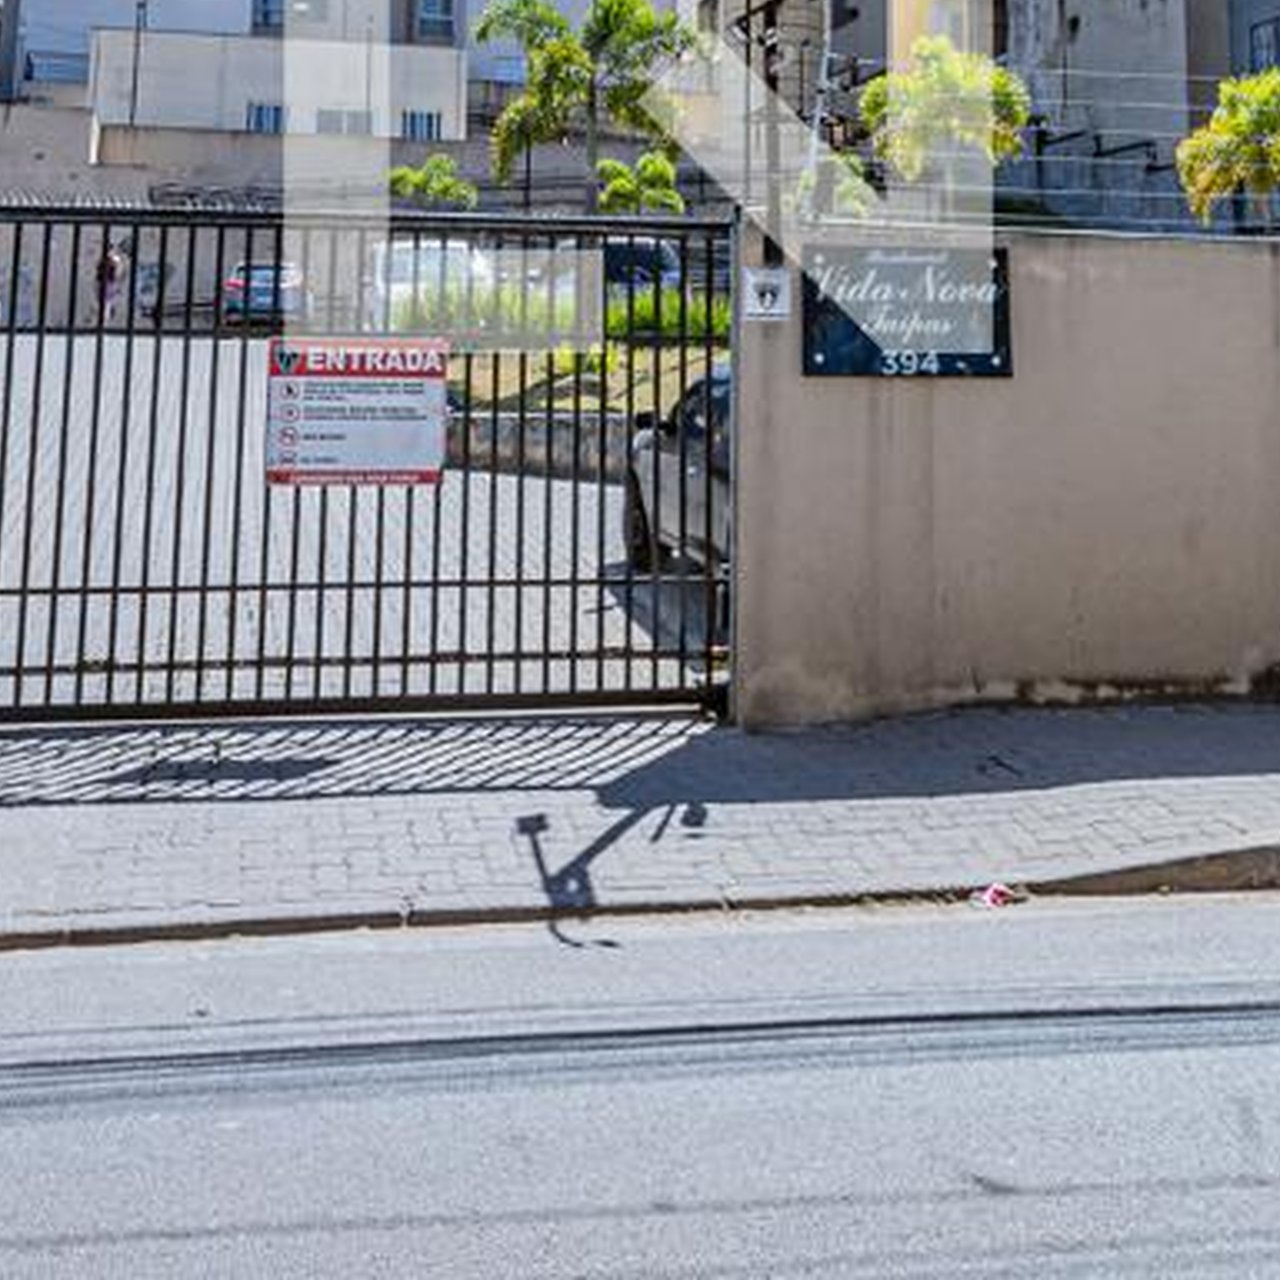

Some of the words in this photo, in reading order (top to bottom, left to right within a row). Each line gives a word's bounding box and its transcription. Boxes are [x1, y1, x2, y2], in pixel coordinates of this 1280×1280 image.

[809, 265, 894, 302] Vida
[900, 265, 1003, 303] Nova
[307, 346, 443, 372] ENTRADA
[881, 350, 940, 376] 394
